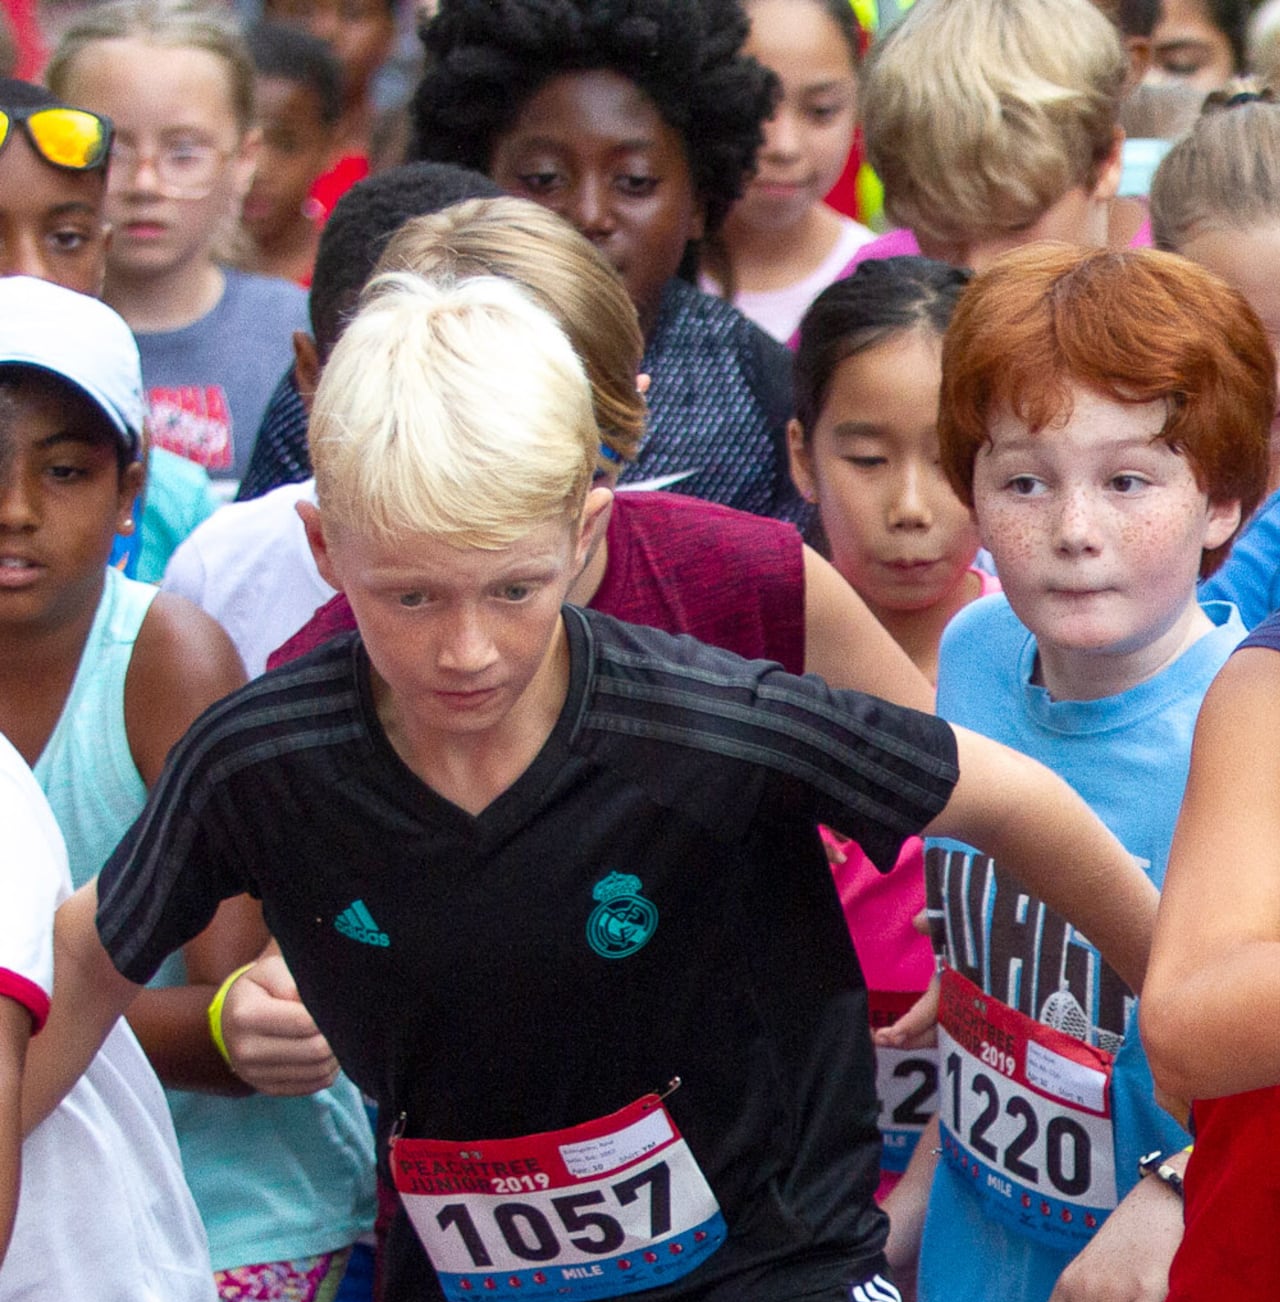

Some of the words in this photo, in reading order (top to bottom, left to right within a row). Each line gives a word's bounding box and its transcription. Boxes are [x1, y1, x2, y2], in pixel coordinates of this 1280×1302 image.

[333, 919, 390, 947] adidas
[980, 1041, 1016, 1076] 2019
[946, 1052, 1092, 1196] 1220
[400, 1157, 543, 1177] PEACHTREE
[410, 1175, 491, 1193] JUNIOR
[491, 1173, 550, 1194] 2019
[987, 1173, 1013, 1198] MILE
[436, 1160, 671, 1268] 1057
[561, 1265, 604, 1281] MILE
